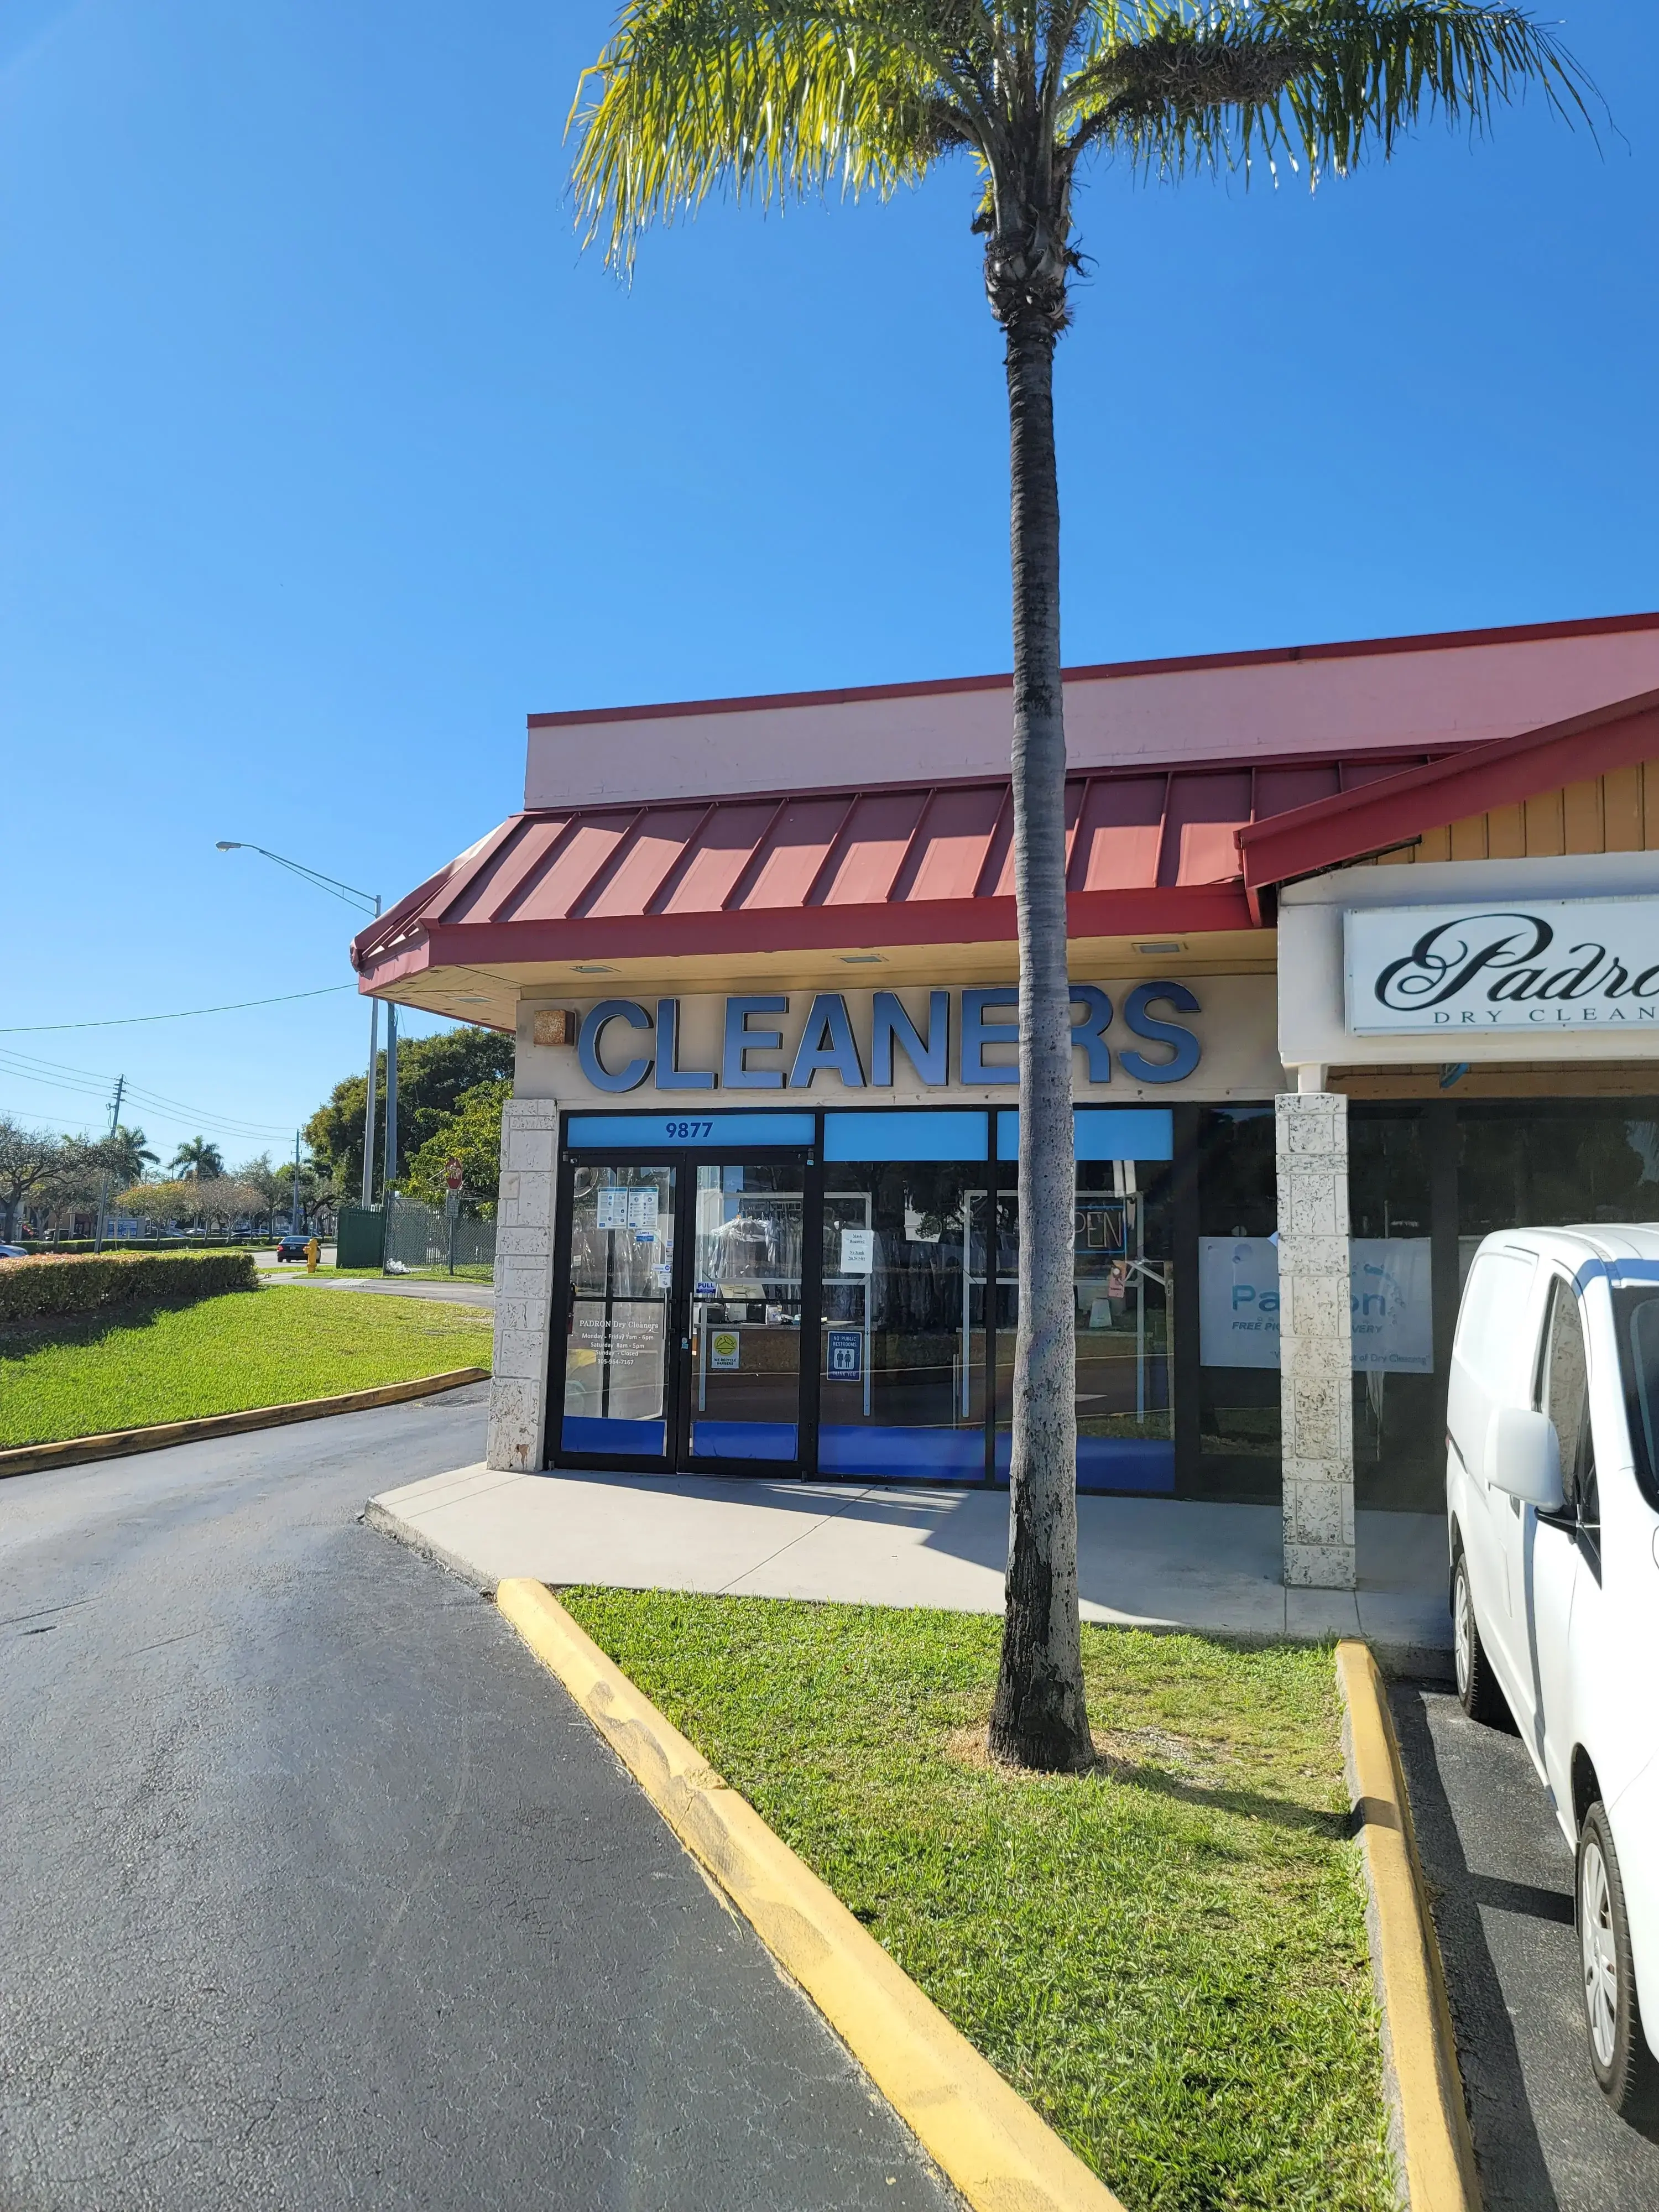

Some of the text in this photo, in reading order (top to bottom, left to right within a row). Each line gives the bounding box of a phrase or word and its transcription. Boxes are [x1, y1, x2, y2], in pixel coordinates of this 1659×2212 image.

[1433, 1006, 1656, 1024] DRY CLEAN
[578, 980, 1202, 1093] CLEANERS
[666, 1122, 713, 1138] 9877
[1074, 1212, 1121, 1248] PEN
[1232, 1285, 1386, 1316] Pan
[1232, 1321, 1262, 1330] FREE
[1370, 1354, 1386, 1363] Dry
